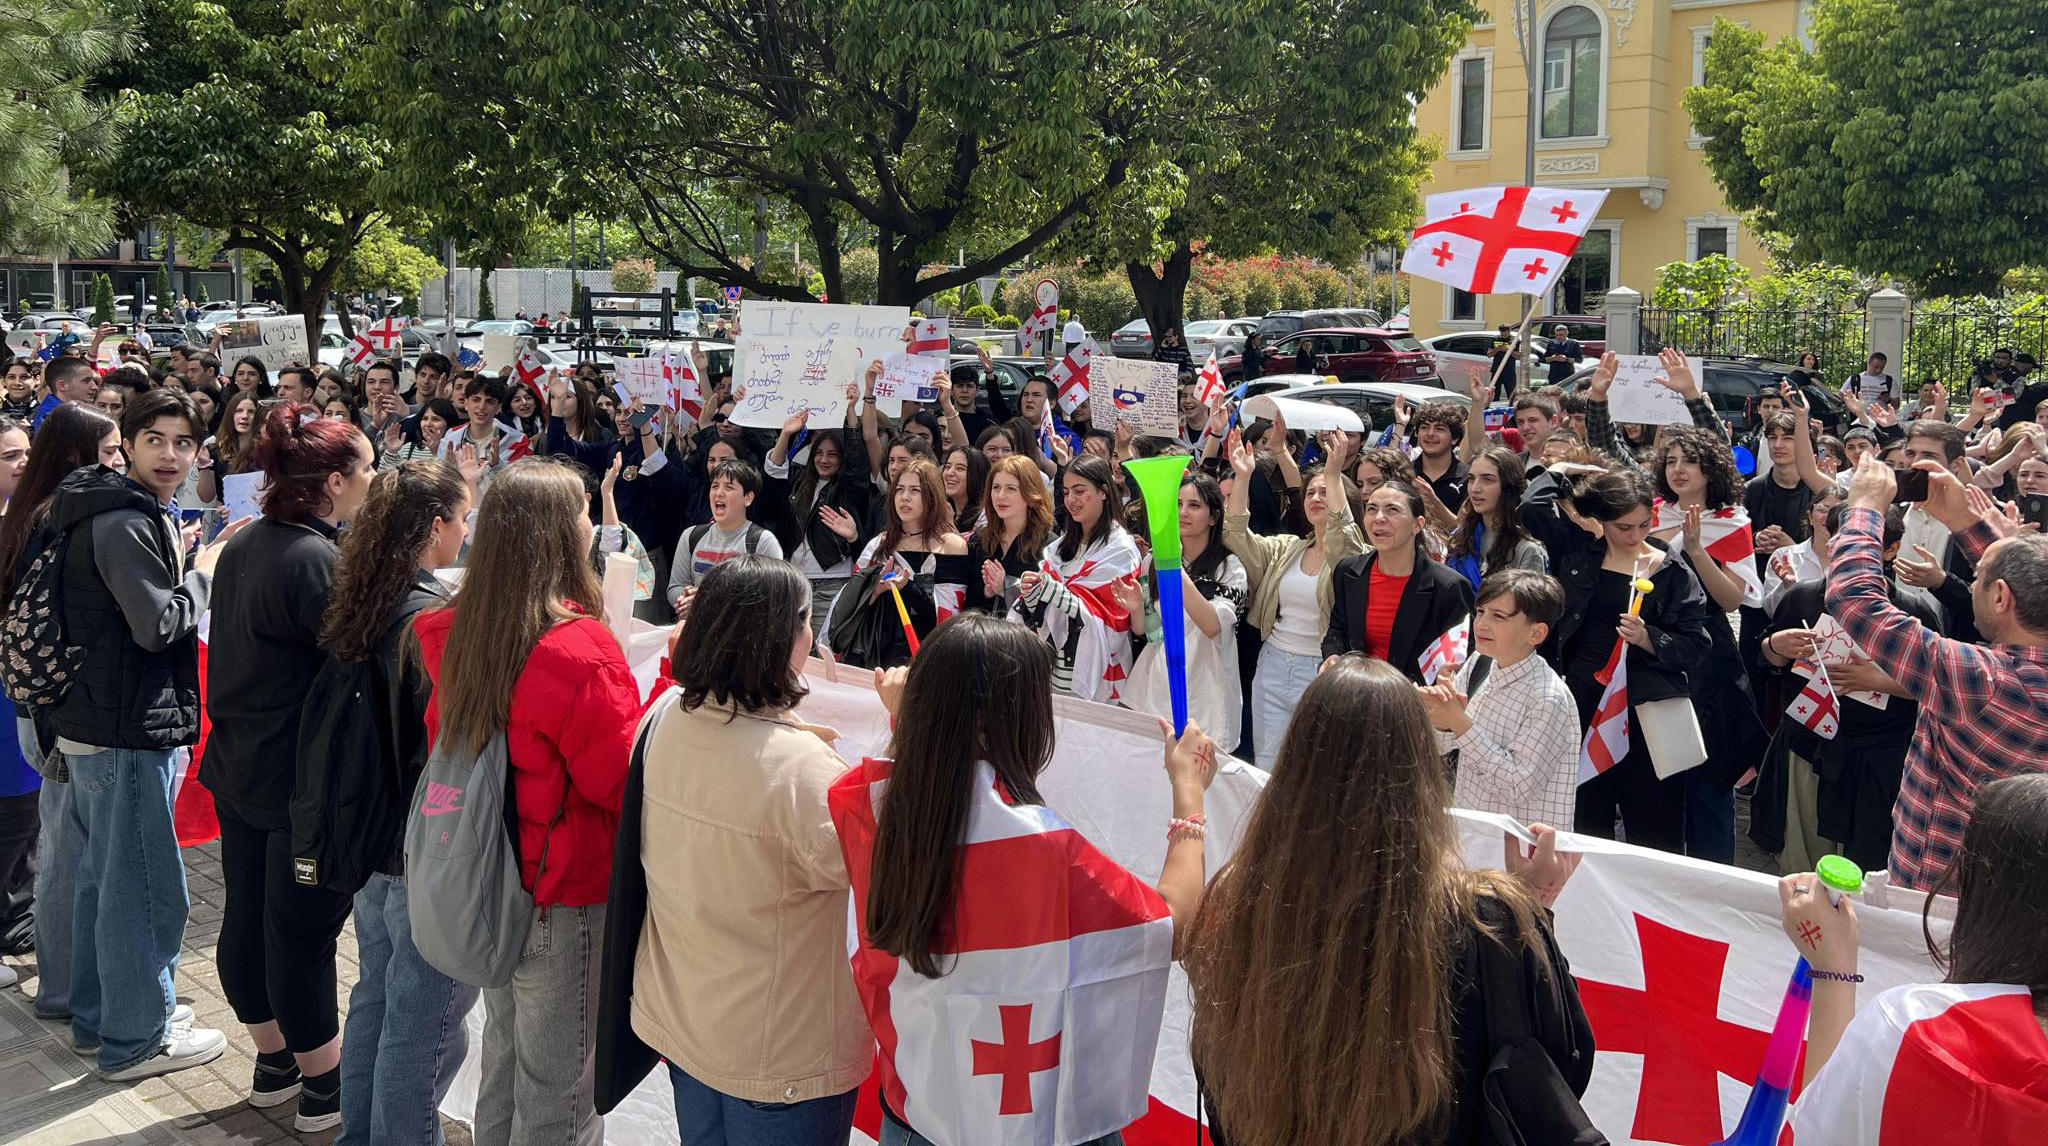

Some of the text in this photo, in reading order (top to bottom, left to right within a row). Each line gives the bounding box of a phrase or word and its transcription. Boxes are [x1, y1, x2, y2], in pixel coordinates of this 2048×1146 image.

[752, 307, 902, 341] If we burn
[427, 781, 464, 807] NIKE
